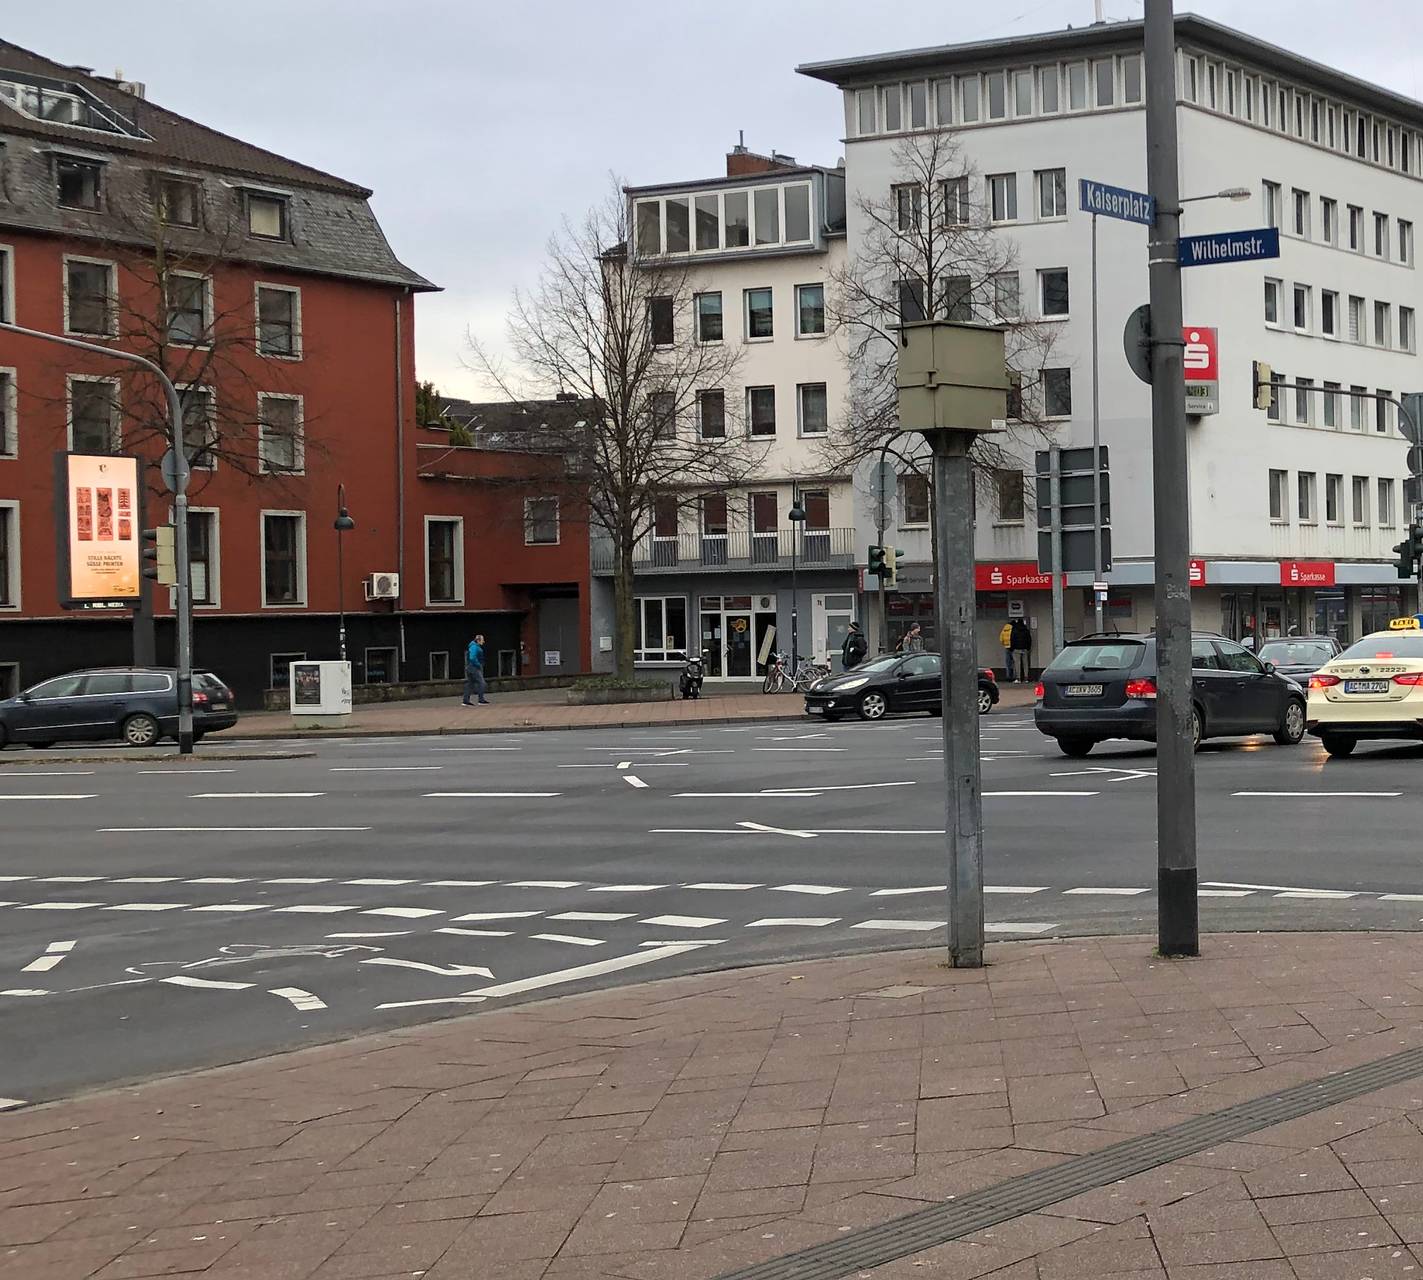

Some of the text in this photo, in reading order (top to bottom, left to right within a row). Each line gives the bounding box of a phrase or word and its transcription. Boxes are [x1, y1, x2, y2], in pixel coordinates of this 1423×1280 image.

[1086, 183, 1150, 220] Kaiserplatz
[1191, 237, 1265, 260] Wilhelmstr.
[1006, 574, 1049, 585] Sparkasse
[1300, 572, 1326, 583] Sparkasse
